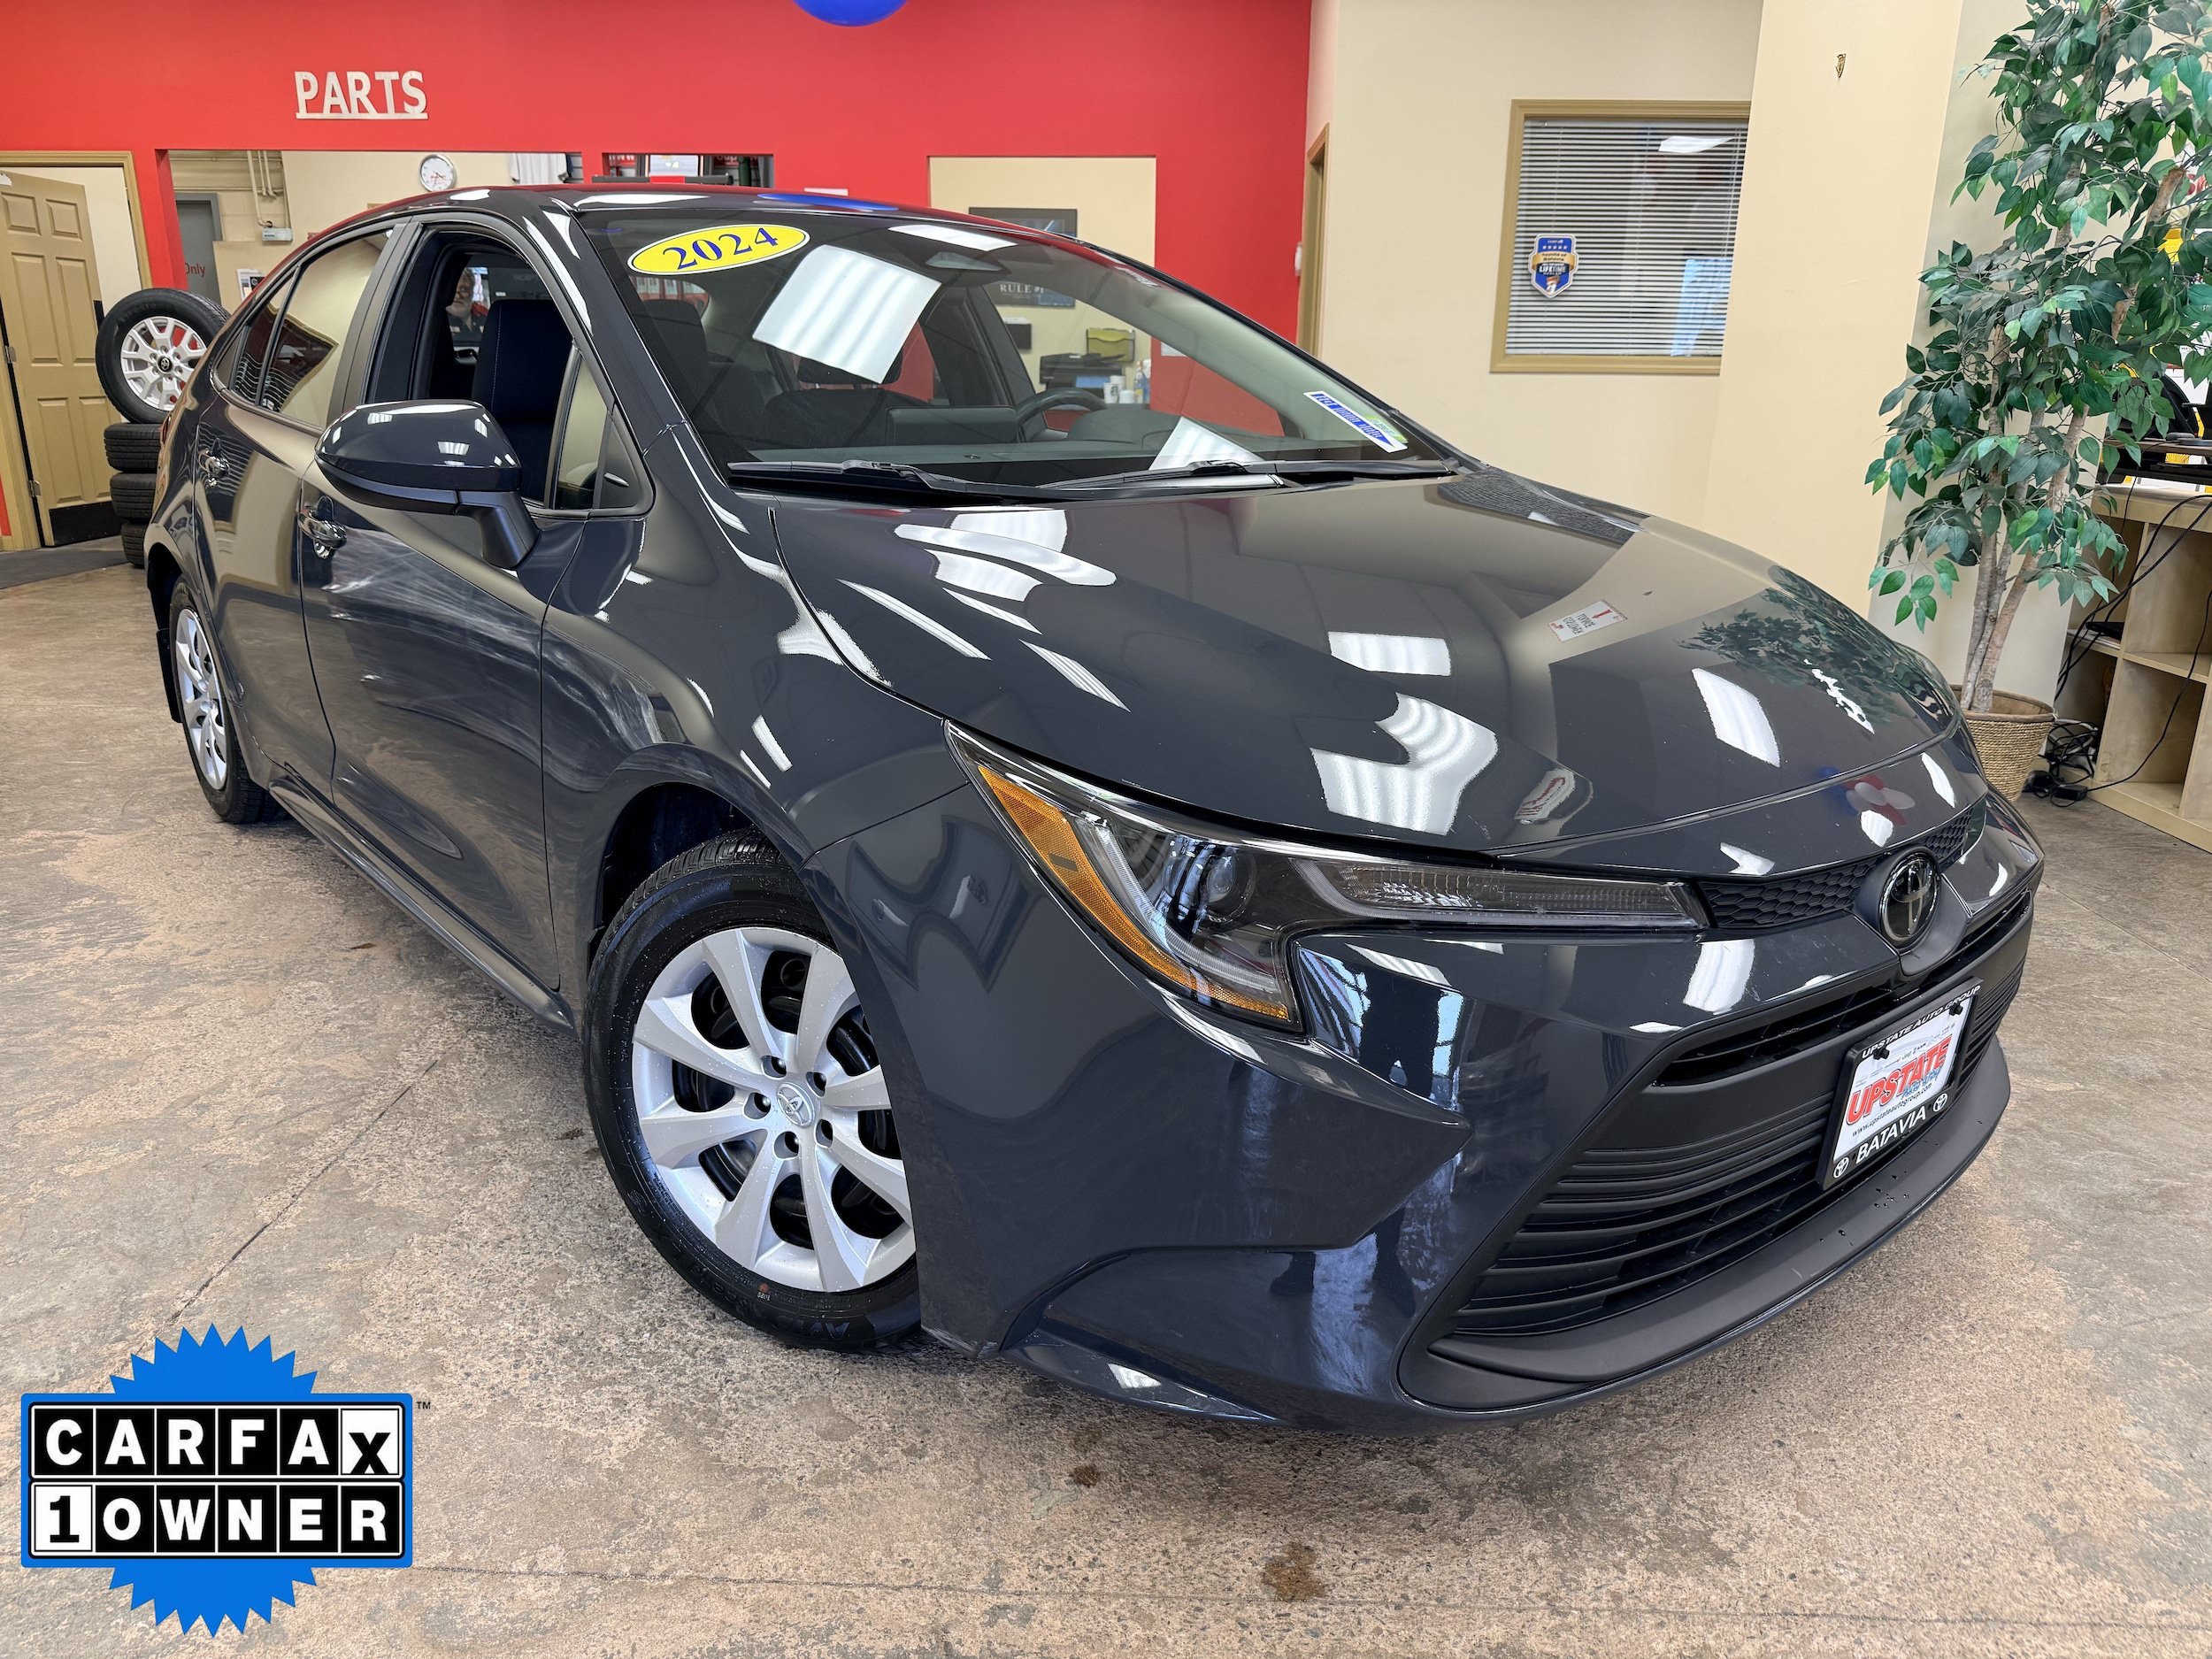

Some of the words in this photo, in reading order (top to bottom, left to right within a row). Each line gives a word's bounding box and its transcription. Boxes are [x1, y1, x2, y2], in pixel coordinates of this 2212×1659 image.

[295, 70, 428, 116] PARTS
[663, 227, 779, 270] 2024
[999, 283, 1032, 294] RULE
[1862, 1025, 1913, 1059] UPSTATE
[1913, 1007, 1943, 1029] AUTO
[1944, 985, 1981, 1010] GROUP
[1846, 1033, 1953, 1126] UPSTATE
[1852, 1082, 1933, 1138] www.upstateautogroup.com
[1855, 1105, 1927, 1164] BATAVIA
